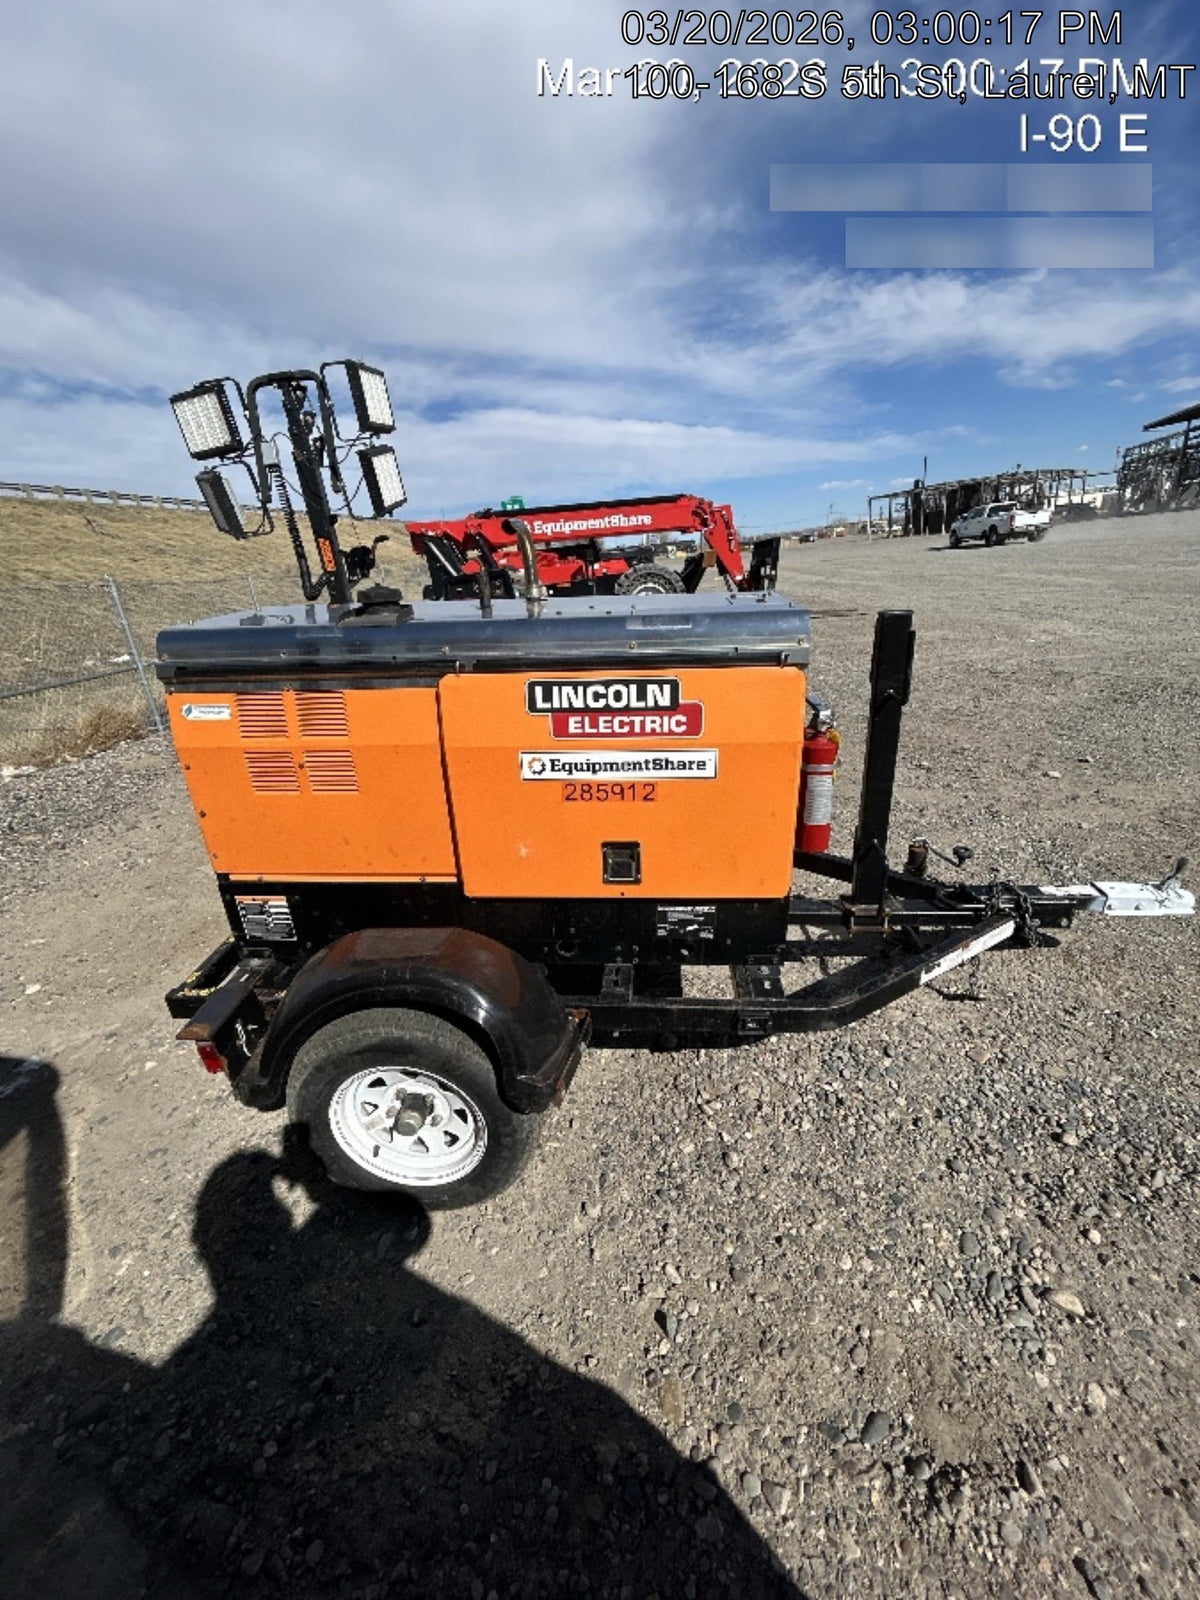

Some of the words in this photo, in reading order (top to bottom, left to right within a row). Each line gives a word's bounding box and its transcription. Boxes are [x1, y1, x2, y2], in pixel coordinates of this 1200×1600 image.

[533, 514, 652, 535] EquipmentShare
[534, 683, 671, 709] LINCOLN
[568, 714, 688, 734] ELECTRIC
[549, 758, 707, 775] EquipmentShare
[564, 783, 656, 802] 285912
